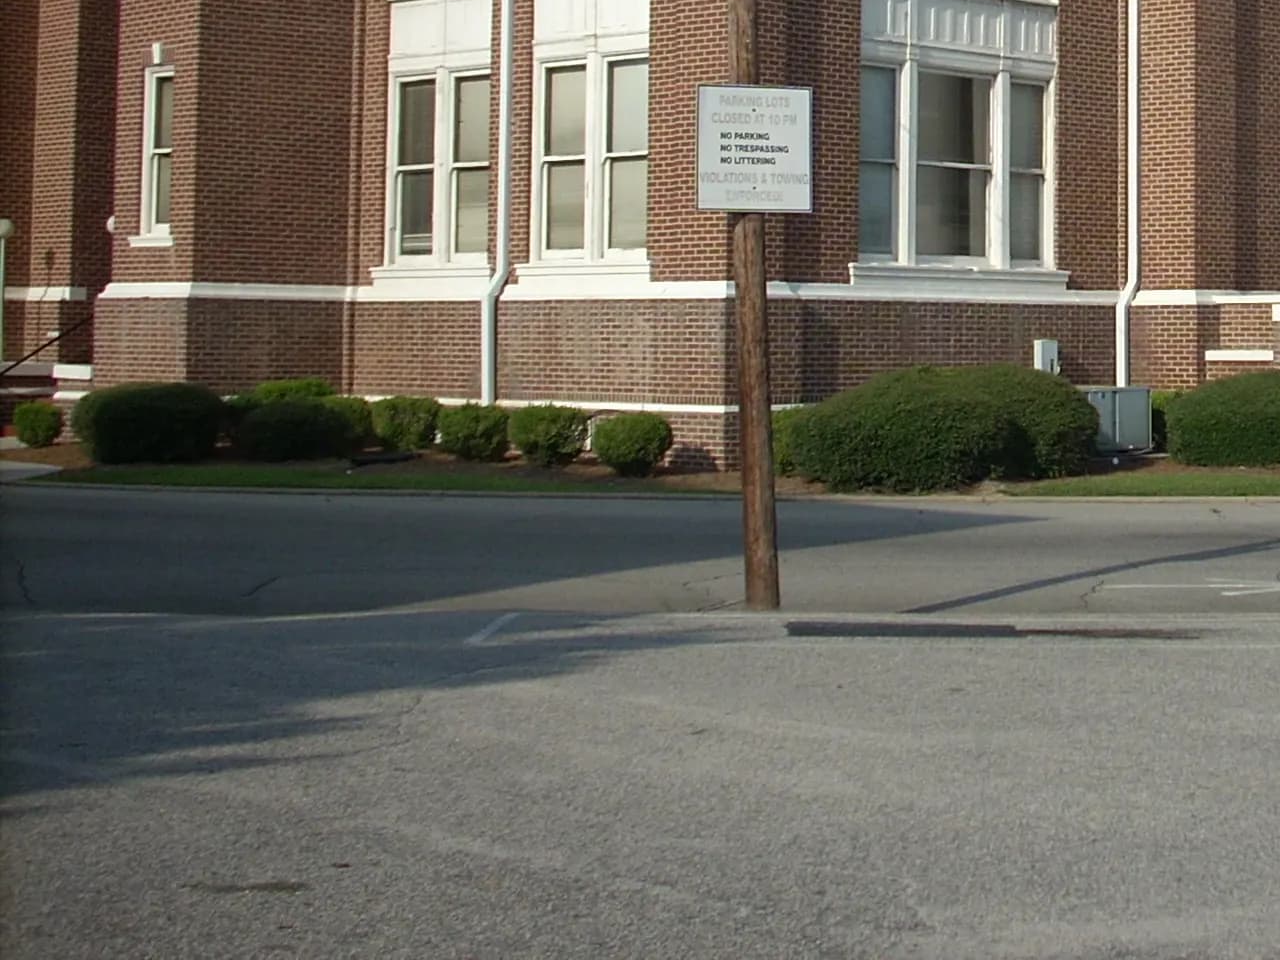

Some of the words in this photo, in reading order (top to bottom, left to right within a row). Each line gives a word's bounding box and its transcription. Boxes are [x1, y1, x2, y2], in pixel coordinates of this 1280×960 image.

[719, 95, 763, 107] PARKING
[765, 96, 791, 108] LOTS
[711, 112, 751, 124] CLOSED
[754, 114, 766, 125] AT
[769, 114, 781, 126] 10
[783, 115, 797, 126] PM
[720, 132, 732, 140] NO
[734, 132, 770, 141] PARKING
[720, 144, 732, 152] NO
[734, 145, 789, 153] TRESPASSING
[720, 157, 732, 165] NO
[734, 157, 776, 165] LITTERING
[700, 172, 757, 184] VIOLATIONS
[771, 173, 809, 185] TOWING
